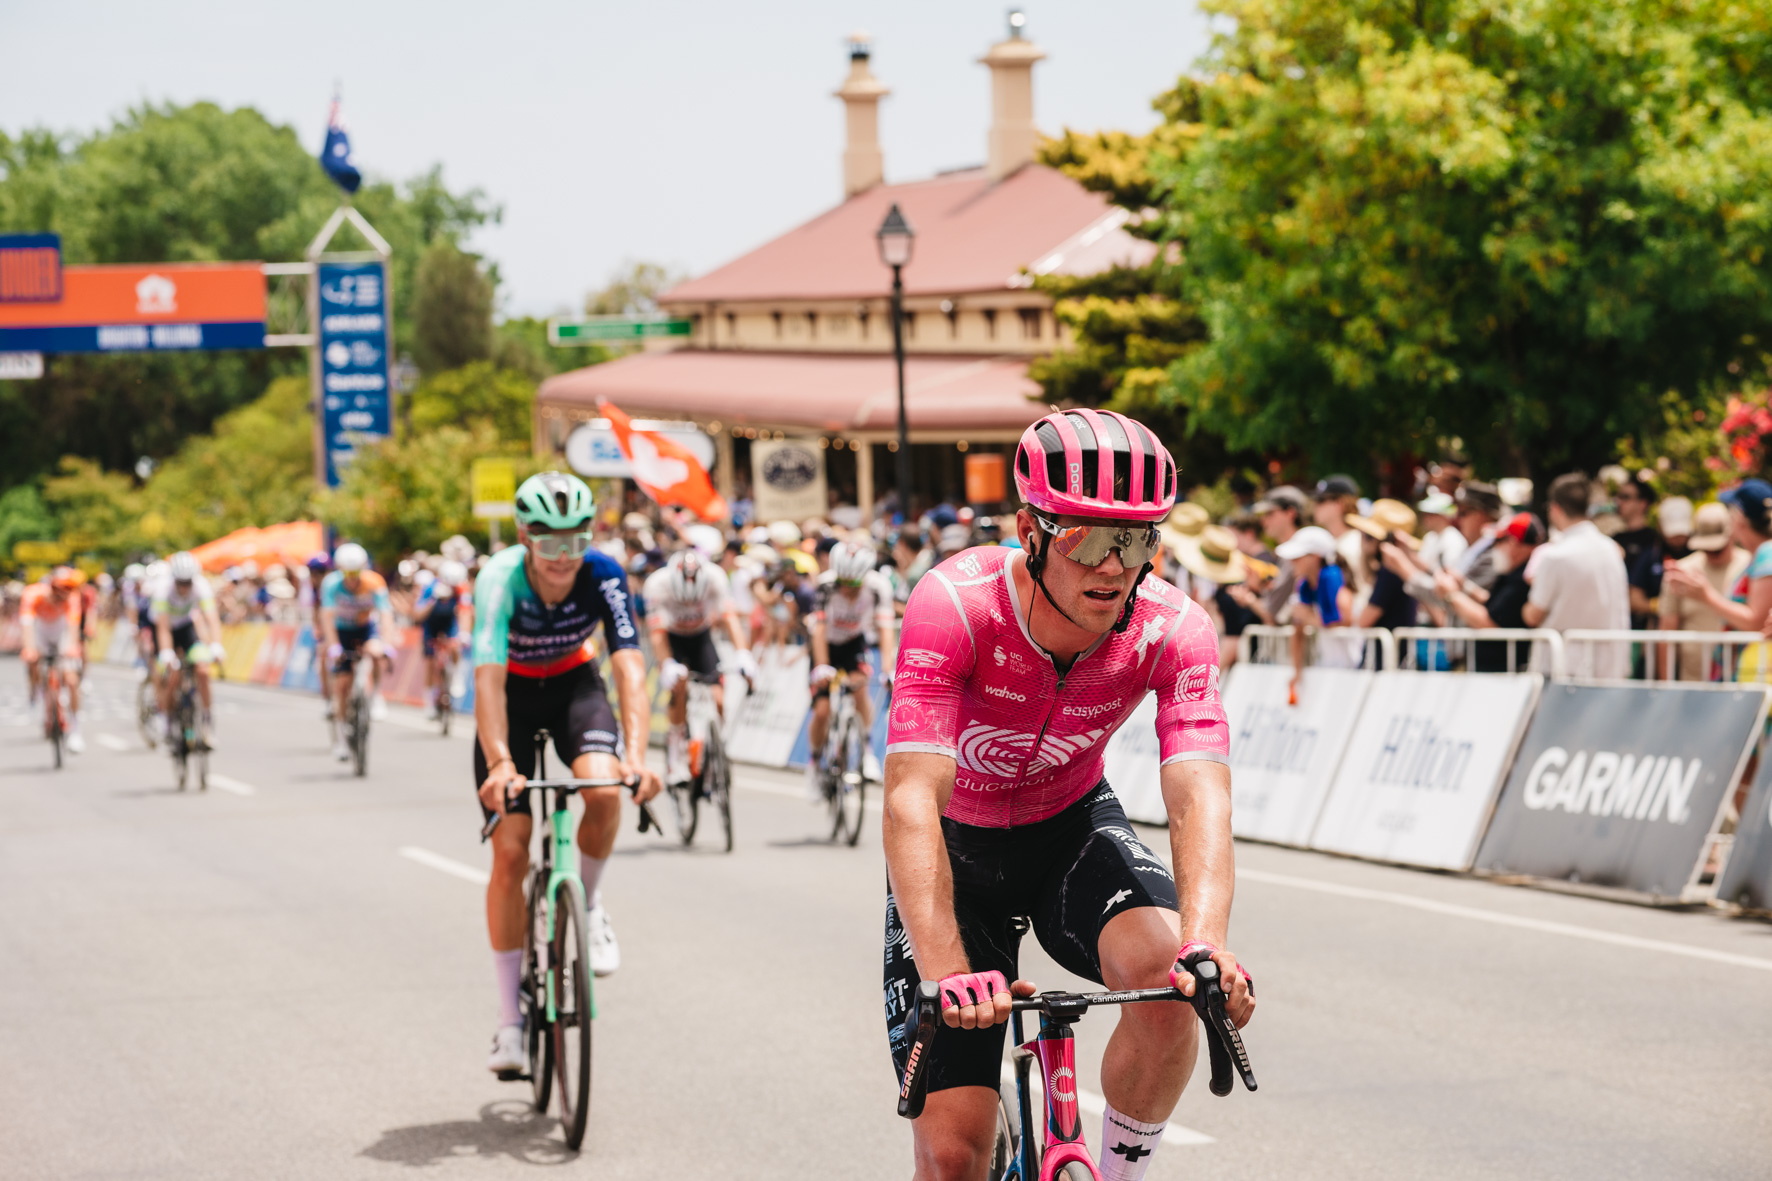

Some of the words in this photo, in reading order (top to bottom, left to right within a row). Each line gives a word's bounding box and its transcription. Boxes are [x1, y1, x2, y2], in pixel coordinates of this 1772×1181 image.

[1010, 651, 1023, 662] UCI
[985, 684, 1027, 702] wahoo
[1062, 697, 1123, 720] easypost
[1369, 713, 1475, 791] Hilton
[1523, 746, 1702, 824] GARMIN
[1092, 992, 1140, 1003] cannondale
[1222, 1017, 1251, 1073] SRAM
[900, 1040, 924, 1100] SRAM
